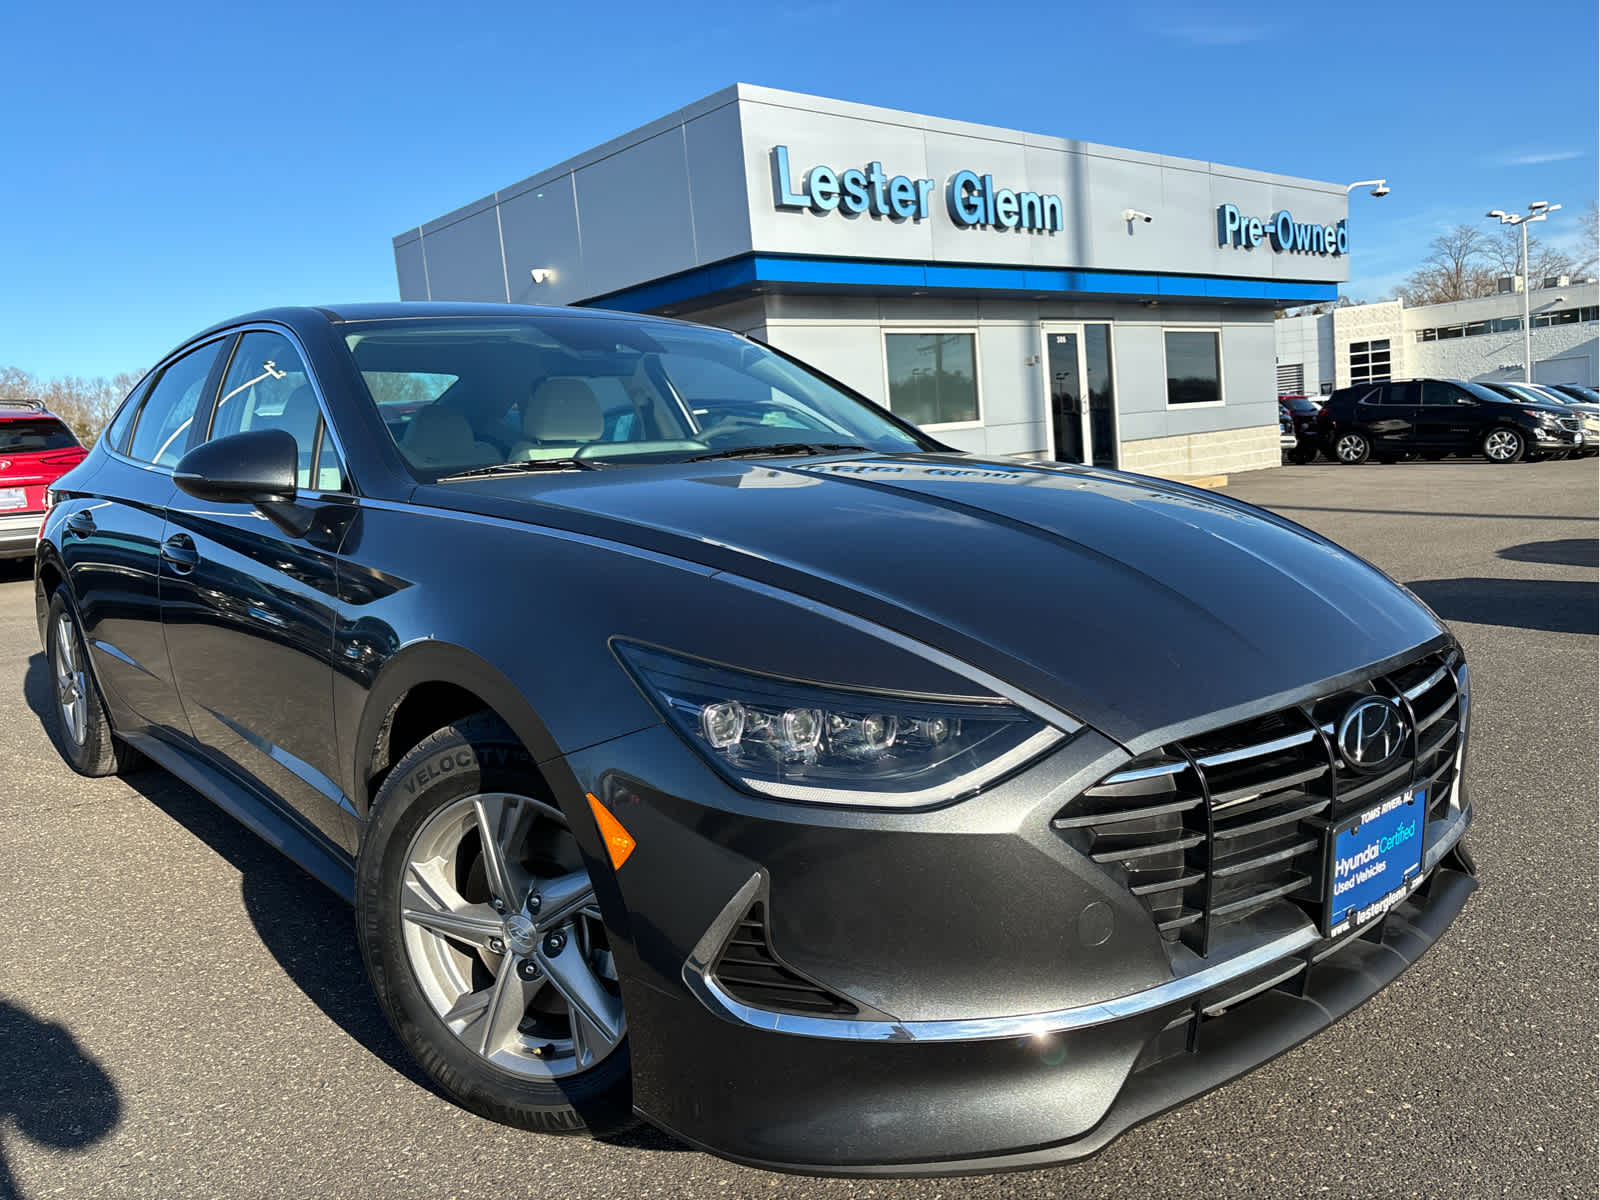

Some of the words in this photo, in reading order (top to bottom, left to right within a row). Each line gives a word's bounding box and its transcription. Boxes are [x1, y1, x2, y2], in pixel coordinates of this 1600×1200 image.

[769, 145, 934, 224] Lester
[946, 169, 1064, 233] Glenn
[1217, 203, 1349, 257] Pre-Owned
[1360, 806, 1381, 825] TOMS
[1335, 839, 1380, 878] Hyundai
[1379, 819, 1416, 854] Certified
[1334, 874, 1355, 896] Used
[1355, 860, 1387, 885] Vehicles
[1356, 886, 1407, 925] lesterglenn
